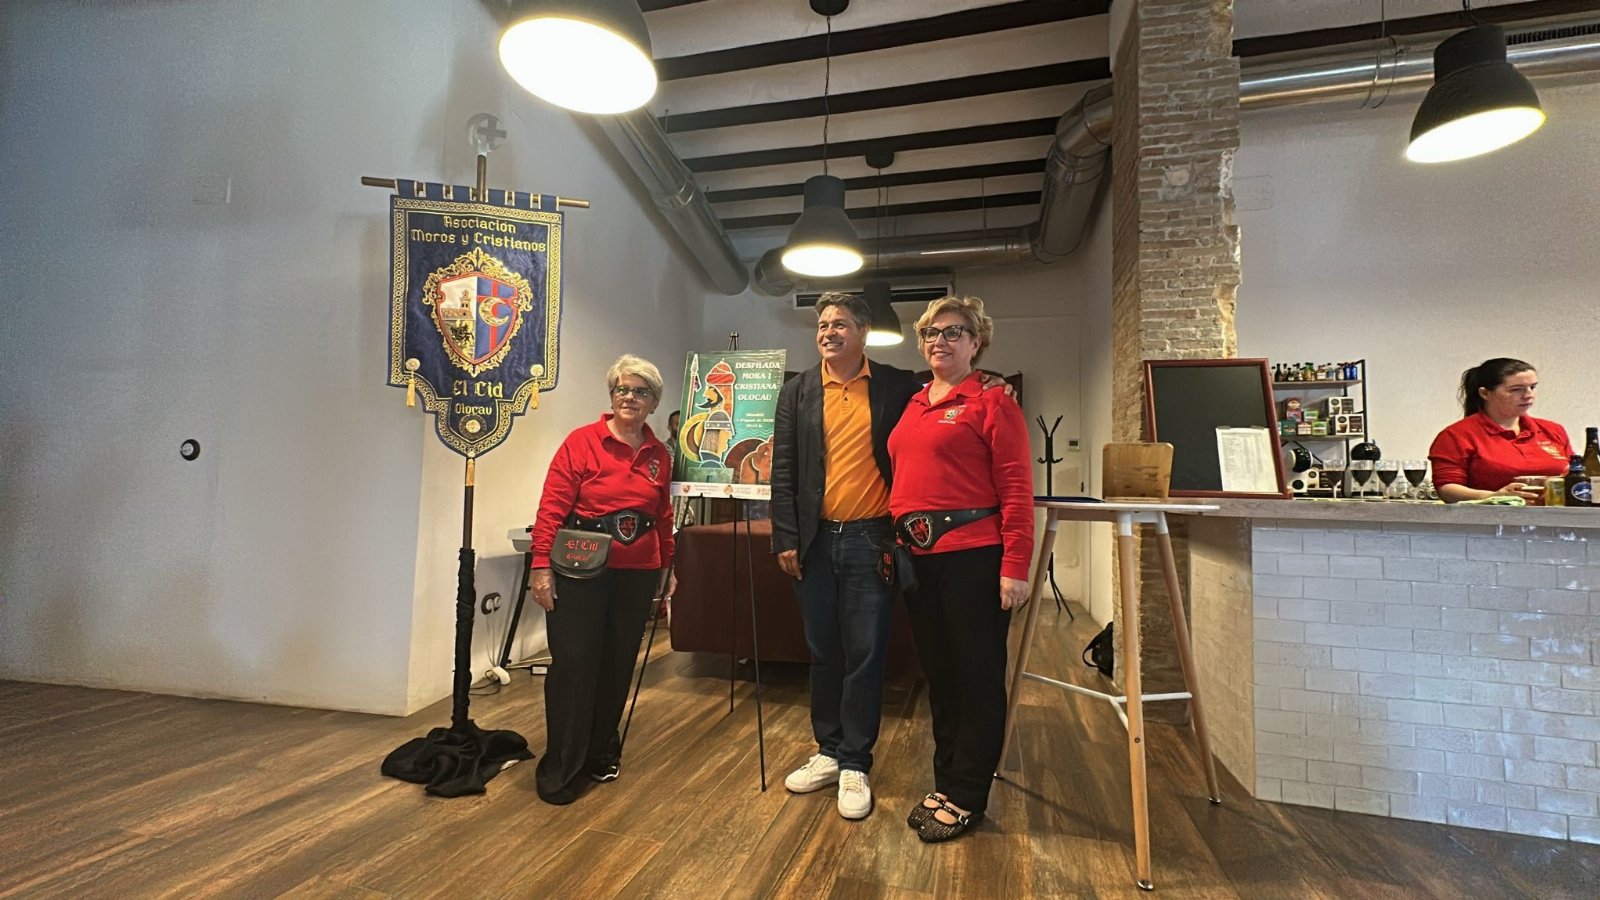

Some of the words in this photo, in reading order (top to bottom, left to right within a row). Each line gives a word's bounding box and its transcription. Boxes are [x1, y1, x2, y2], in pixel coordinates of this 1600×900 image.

[443, 215, 516, 234] Asociación
[410, 229, 456, 243] Moros
[461, 235, 469, 246] y
[473, 232, 546, 252] Cristianos
[453, 380, 468, 396] El
[474, 380, 503, 398] Cid
[455, 402, 493, 415] Olocau
